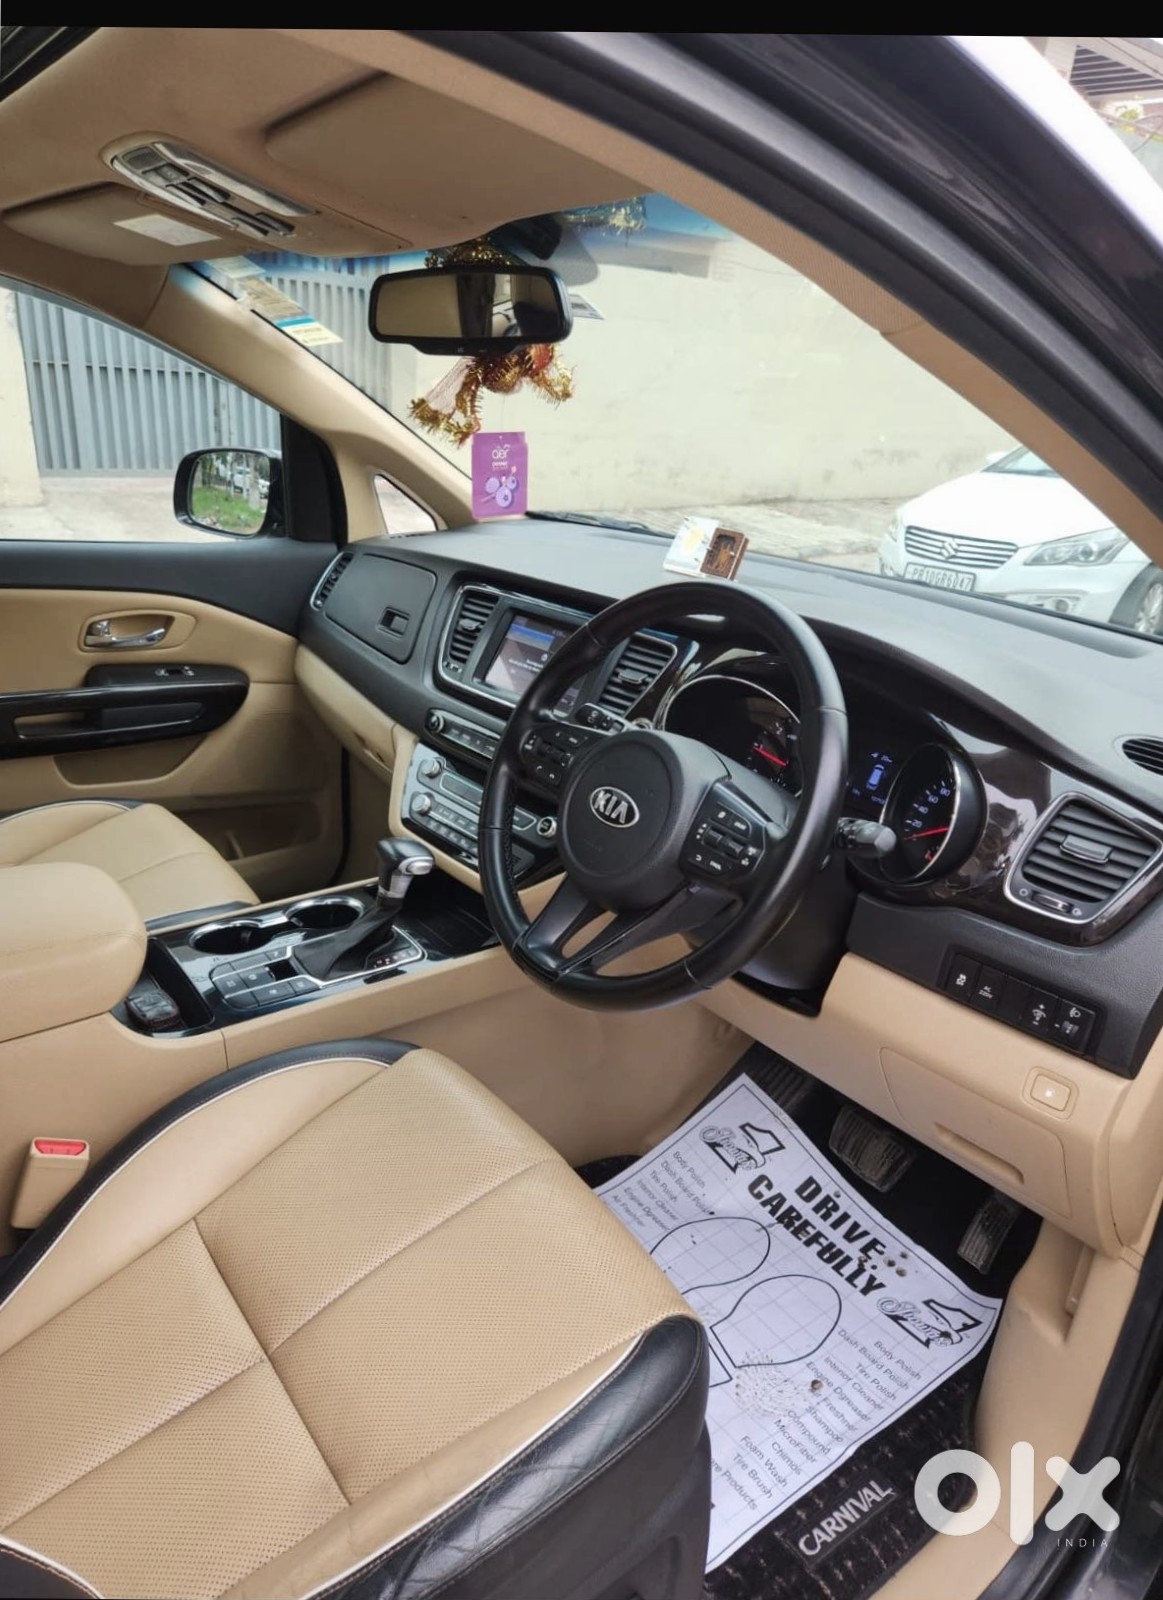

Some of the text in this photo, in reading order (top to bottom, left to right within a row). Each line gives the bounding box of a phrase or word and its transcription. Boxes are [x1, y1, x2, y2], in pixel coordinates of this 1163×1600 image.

[593, 790, 629, 825] KIA
[748, 1174, 887, 1297] CAREFULLY
[794, 1175, 887, 1260] DRIVE
[838, 1328, 859, 1351] Dash
[733, 1453, 773, 1499] Tire Brush
[740, 1435, 788, 1488] Foam Wash
[721, 1469, 758, 1511] Products
[798, 1479, 895, 1556] CARNIVAL
